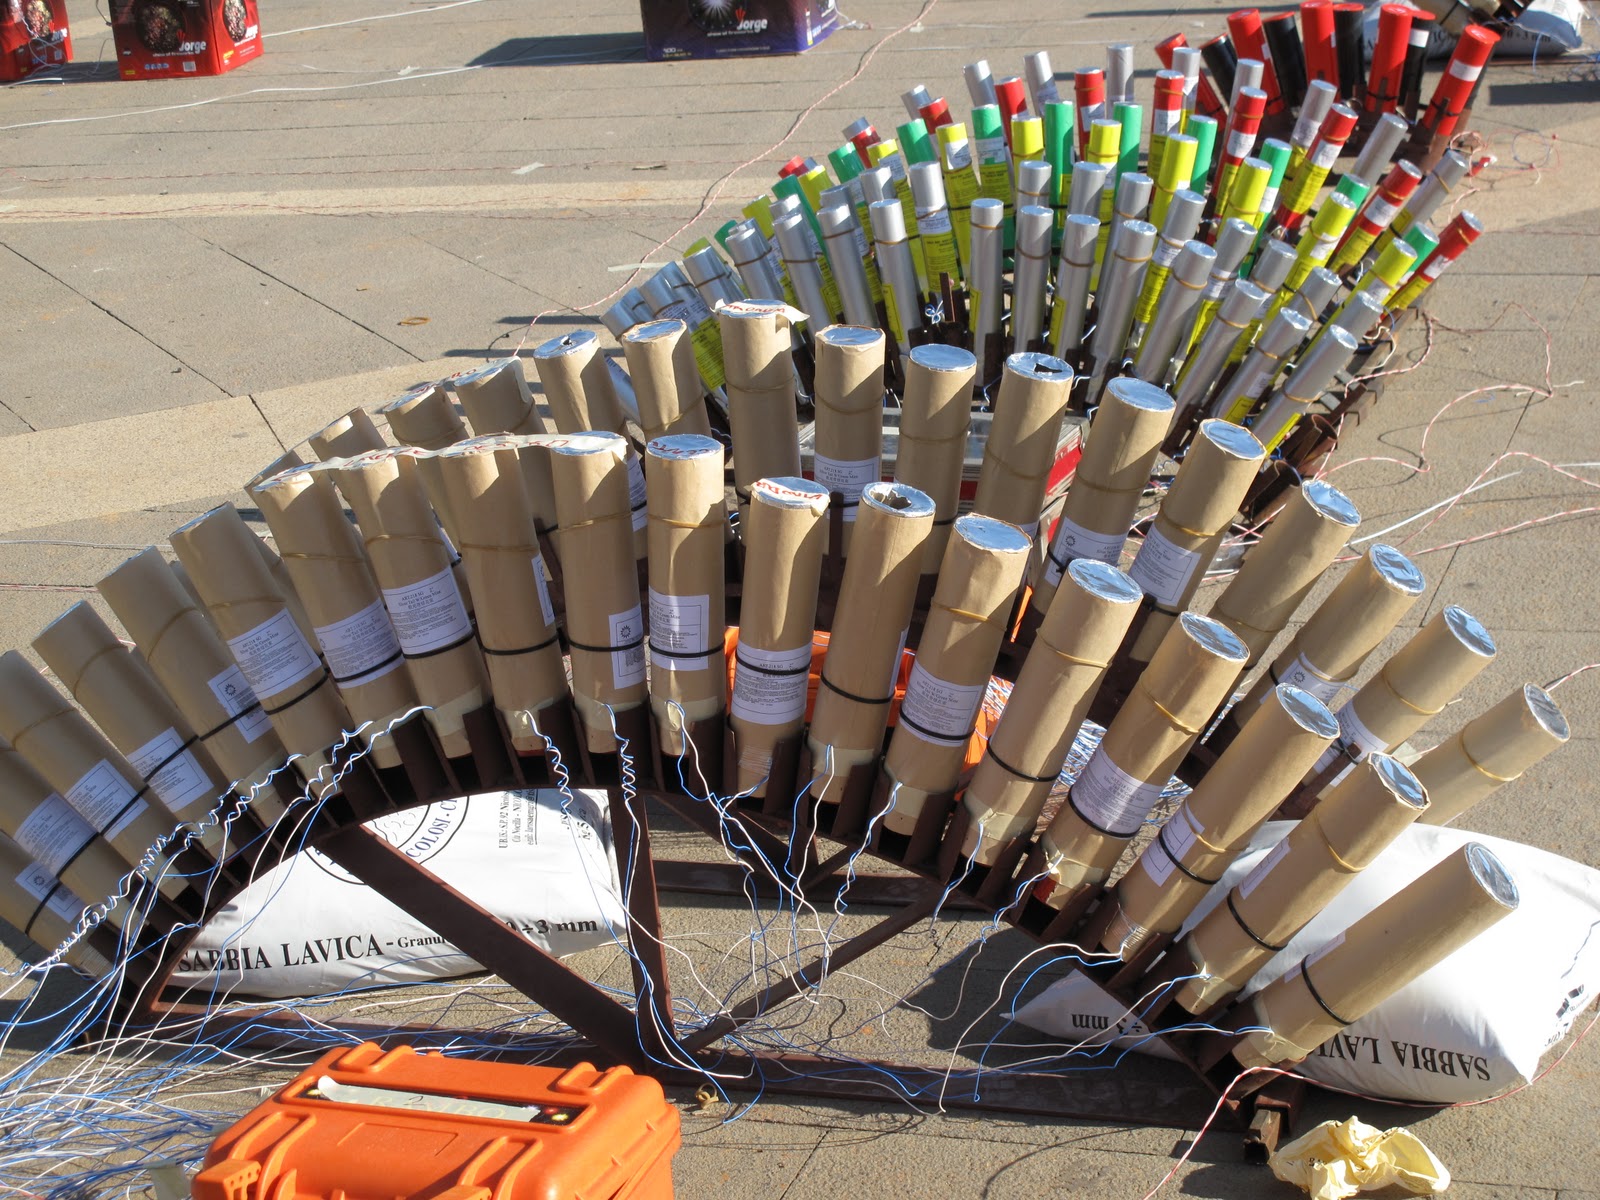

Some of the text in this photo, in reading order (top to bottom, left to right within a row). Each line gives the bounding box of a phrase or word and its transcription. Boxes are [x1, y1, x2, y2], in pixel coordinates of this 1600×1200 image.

[737, 18, 768, 33] Jorge
[179, 40, 206, 54] Jorge
[406, 818, 451, 858] COLOSI
[178, 946, 272, 972] SABBIA
[280, 934, 384, 966] LAVICA
[556, 920, 598, 932] mm
[1072, 1014, 1109, 1030] mm
[1391, 1041, 1491, 1082] SABBIA
[403, 1096, 424, 1106] 2
